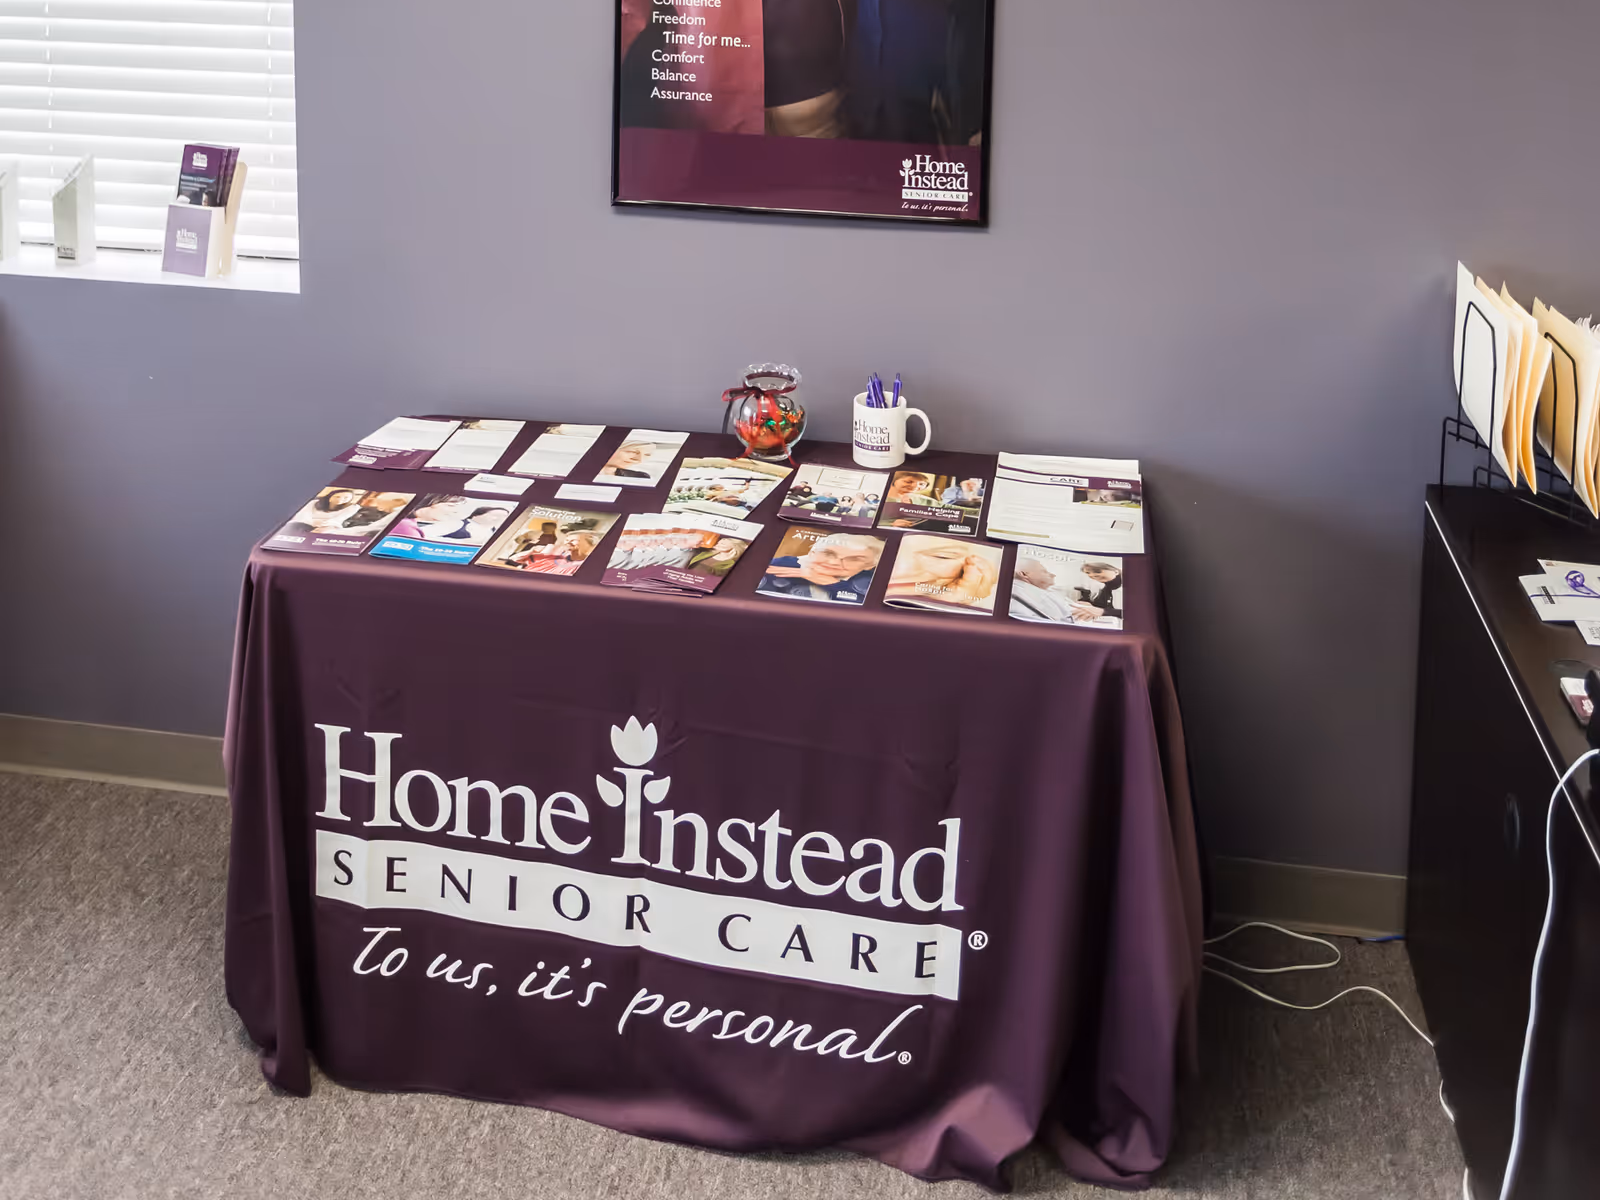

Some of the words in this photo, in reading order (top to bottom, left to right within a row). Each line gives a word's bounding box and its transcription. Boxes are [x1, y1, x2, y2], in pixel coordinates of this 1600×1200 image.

[652, 11, 706, 26] Freedom
[662, 31, 695, 45] Time
[697, 32, 717, 49] for
[721, 36, 751, 48] me...
[651, 49, 704, 64] Comfort
[651, 68, 697, 82] Balance
[650, 86, 713, 101] Assurance
[914, 154, 965, 175] Home
[902, 167, 969, 190] Instead
[904, 191, 939, 199] SENIOR
[942, 193, 966, 201] CARE
[859, 419, 888, 434] Home
[899, 507, 933, 516] Families
[927, 507, 960, 515] Helping
[314, 723, 592, 855] Home
[610, 766, 964, 912] Instead
[333, 850, 652, 934] SENIOR
[353, 926, 409, 977] To
[426, 953, 497, 996] us,
[517, 957, 607, 1007] it's
